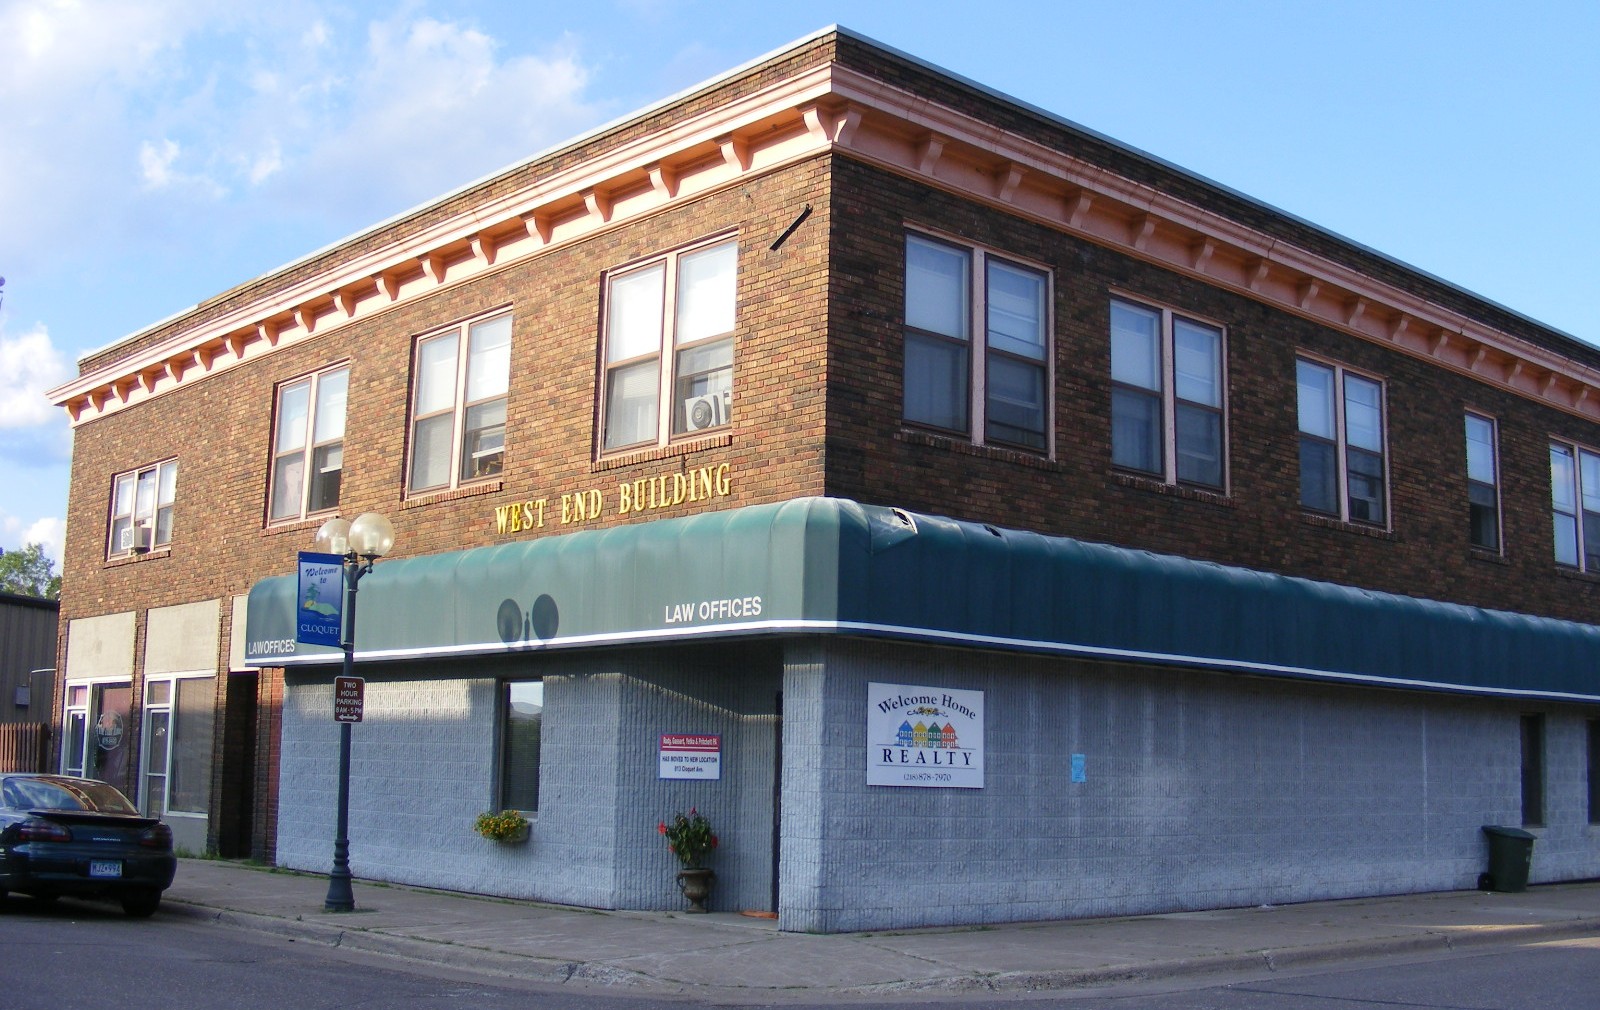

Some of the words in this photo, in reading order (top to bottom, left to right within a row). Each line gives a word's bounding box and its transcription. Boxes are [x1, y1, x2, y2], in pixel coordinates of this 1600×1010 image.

[494, 498, 547, 535] WEST
[560, 488, 603, 525] END
[618, 462, 732, 515] BUILDING
[305, 567, 338, 577] Welcome
[665, 603, 696, 623] LAW
[699, 595, 762, 620] OFFICES
[300, 623, 340, 635] CLOQUET
[343, 681, 357, 689] TWO
[336, 698, 362, 706] PARKING
[878, 695, 938, 715] Welcome
[941, 693, 976, 720] Home
[670, 755, 683, 763] MOVED
[882, 748, 972, 766] REALTY
[681, 765, 695, 773] Cloquet
